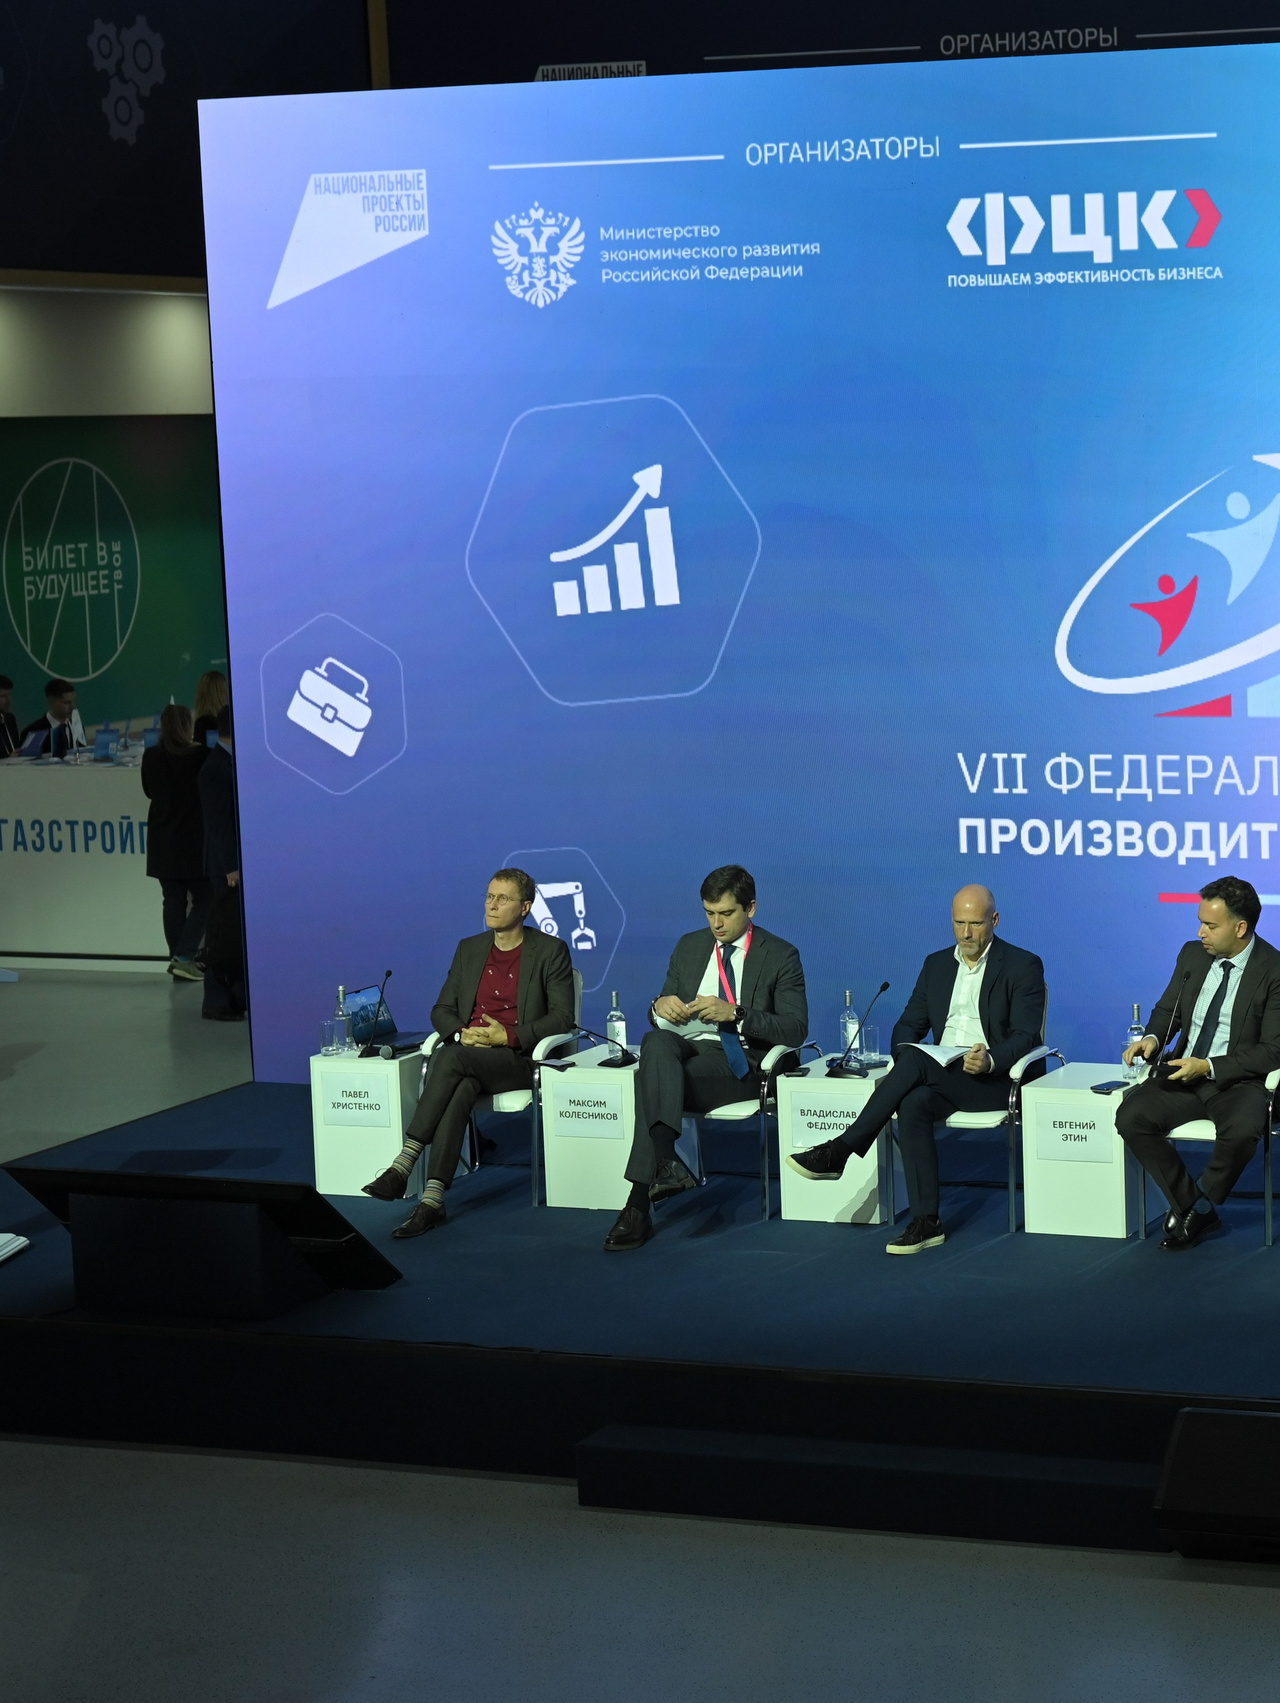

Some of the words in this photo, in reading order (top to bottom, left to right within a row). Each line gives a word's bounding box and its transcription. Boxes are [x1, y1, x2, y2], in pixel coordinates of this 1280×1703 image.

[939, 26, 1119, 55] ОРГАНИЗАТОРЫ
[541, 63, 643, 82] НАЦИОНАЛЬНЫЕ
[745, 135, 941, 167] ОРГАНИЗАТОРЫ
[313, 172, 425, 195] НАЦИОНАЛЬНЫЕ
[361, 194, 426, 214] ПРОЕКТЫ
[374, 213, 427, 234] РОССИИ
[599, 223, 721, 241] Министерство
[600, 245, 738, 263] экономического
[742, 243, 821, 261] развития
[601, 265, 701, 284] Российской
[704, 263, 804, 281] Федерации
[947, 272, 1032, 287] ПОВЫШАЕМ
[1034, 268, 1156, 286] ЭФФЕКТИВНОСТЬ
[1158, 265, 1224, 282] БИЗНЕСА
[22, 542, 89, 572] БИЛЕТ
[97, 540, 109, 566] В
[23, 569, 110, 601] БУДУЩЕЕ
[957, 752, 1029, 795] VII
[341, 1090, 369, 1100] ПАВЕЛ
[568, 1098, 607, 1109] МАКСИМ
[331, 1101, 381, 1112] ХРИСТЕНКО
[559, 1110, 618, 1121] КОЛЕСНИКОВ
[800, 1108, 857, 1119] ВЛАДИСЛАВ
[1052, 1118, 1096, 1131] ЕВГЕНИЙ
[1061, 1132, 1088, 1143] ЭТИН
